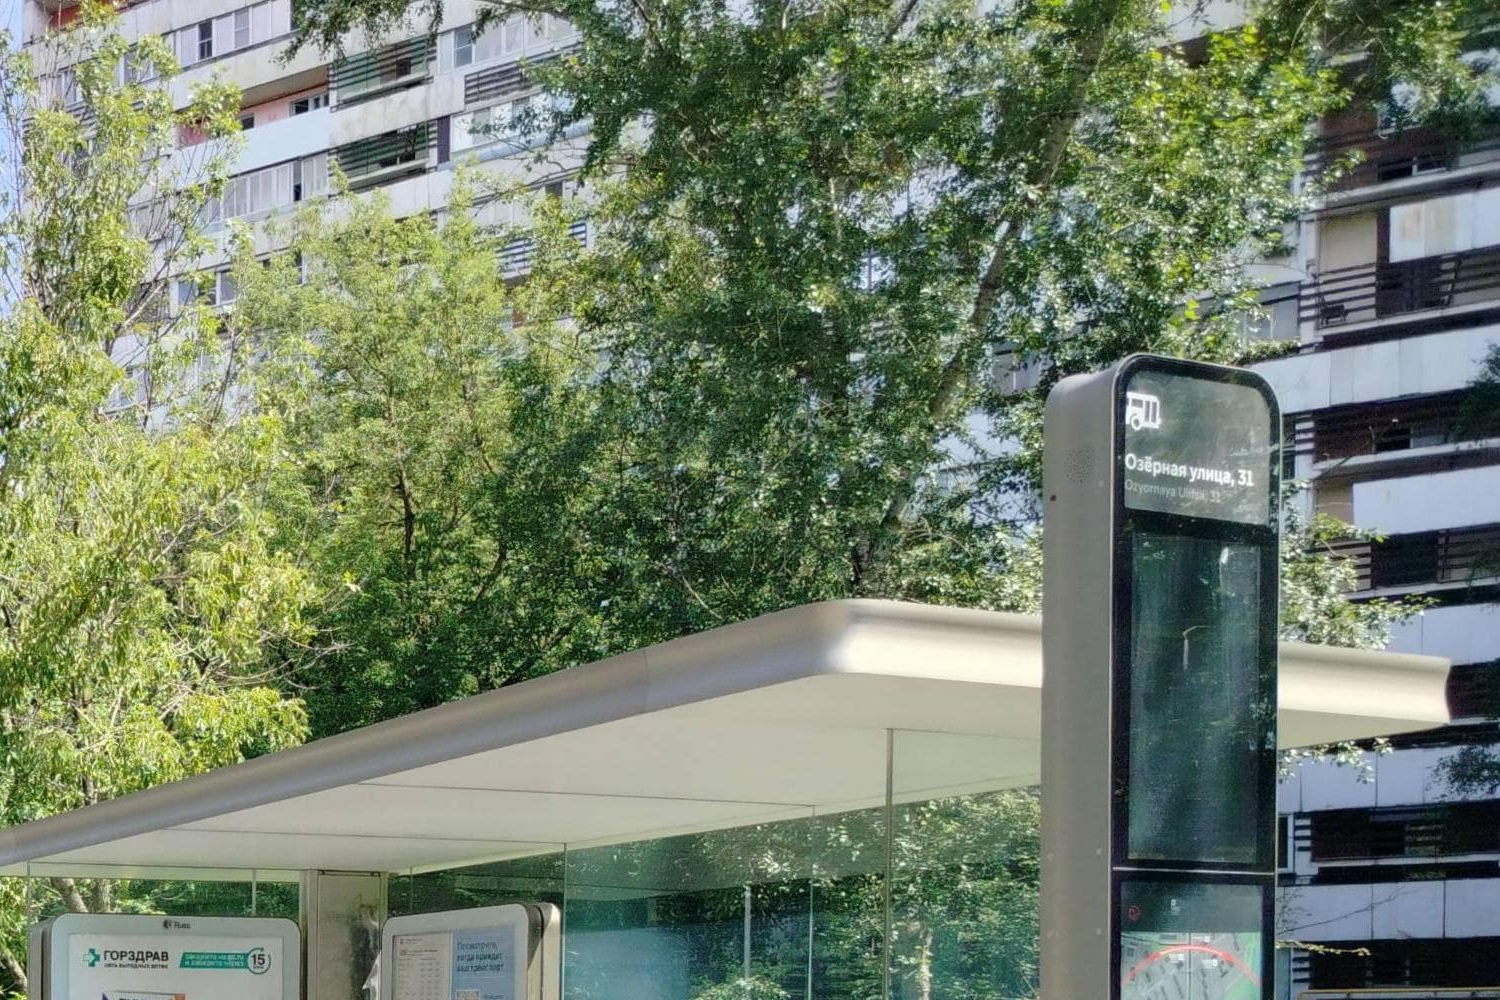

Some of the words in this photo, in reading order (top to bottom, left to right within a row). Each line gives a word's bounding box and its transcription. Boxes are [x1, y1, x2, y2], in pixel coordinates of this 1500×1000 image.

[1125, 453, 1187, 478] Озёрная
[1189, 466, 1235, 487] улица,
[1238, 469, 1254, 487] 31
[1125, 479, 1176, 498] Ozyornaya
[1210, 490, 1221, 503] 31
[103, 950, 169, 963] ГОРЗДРАВ
[252, 953, 266, 966] 15
